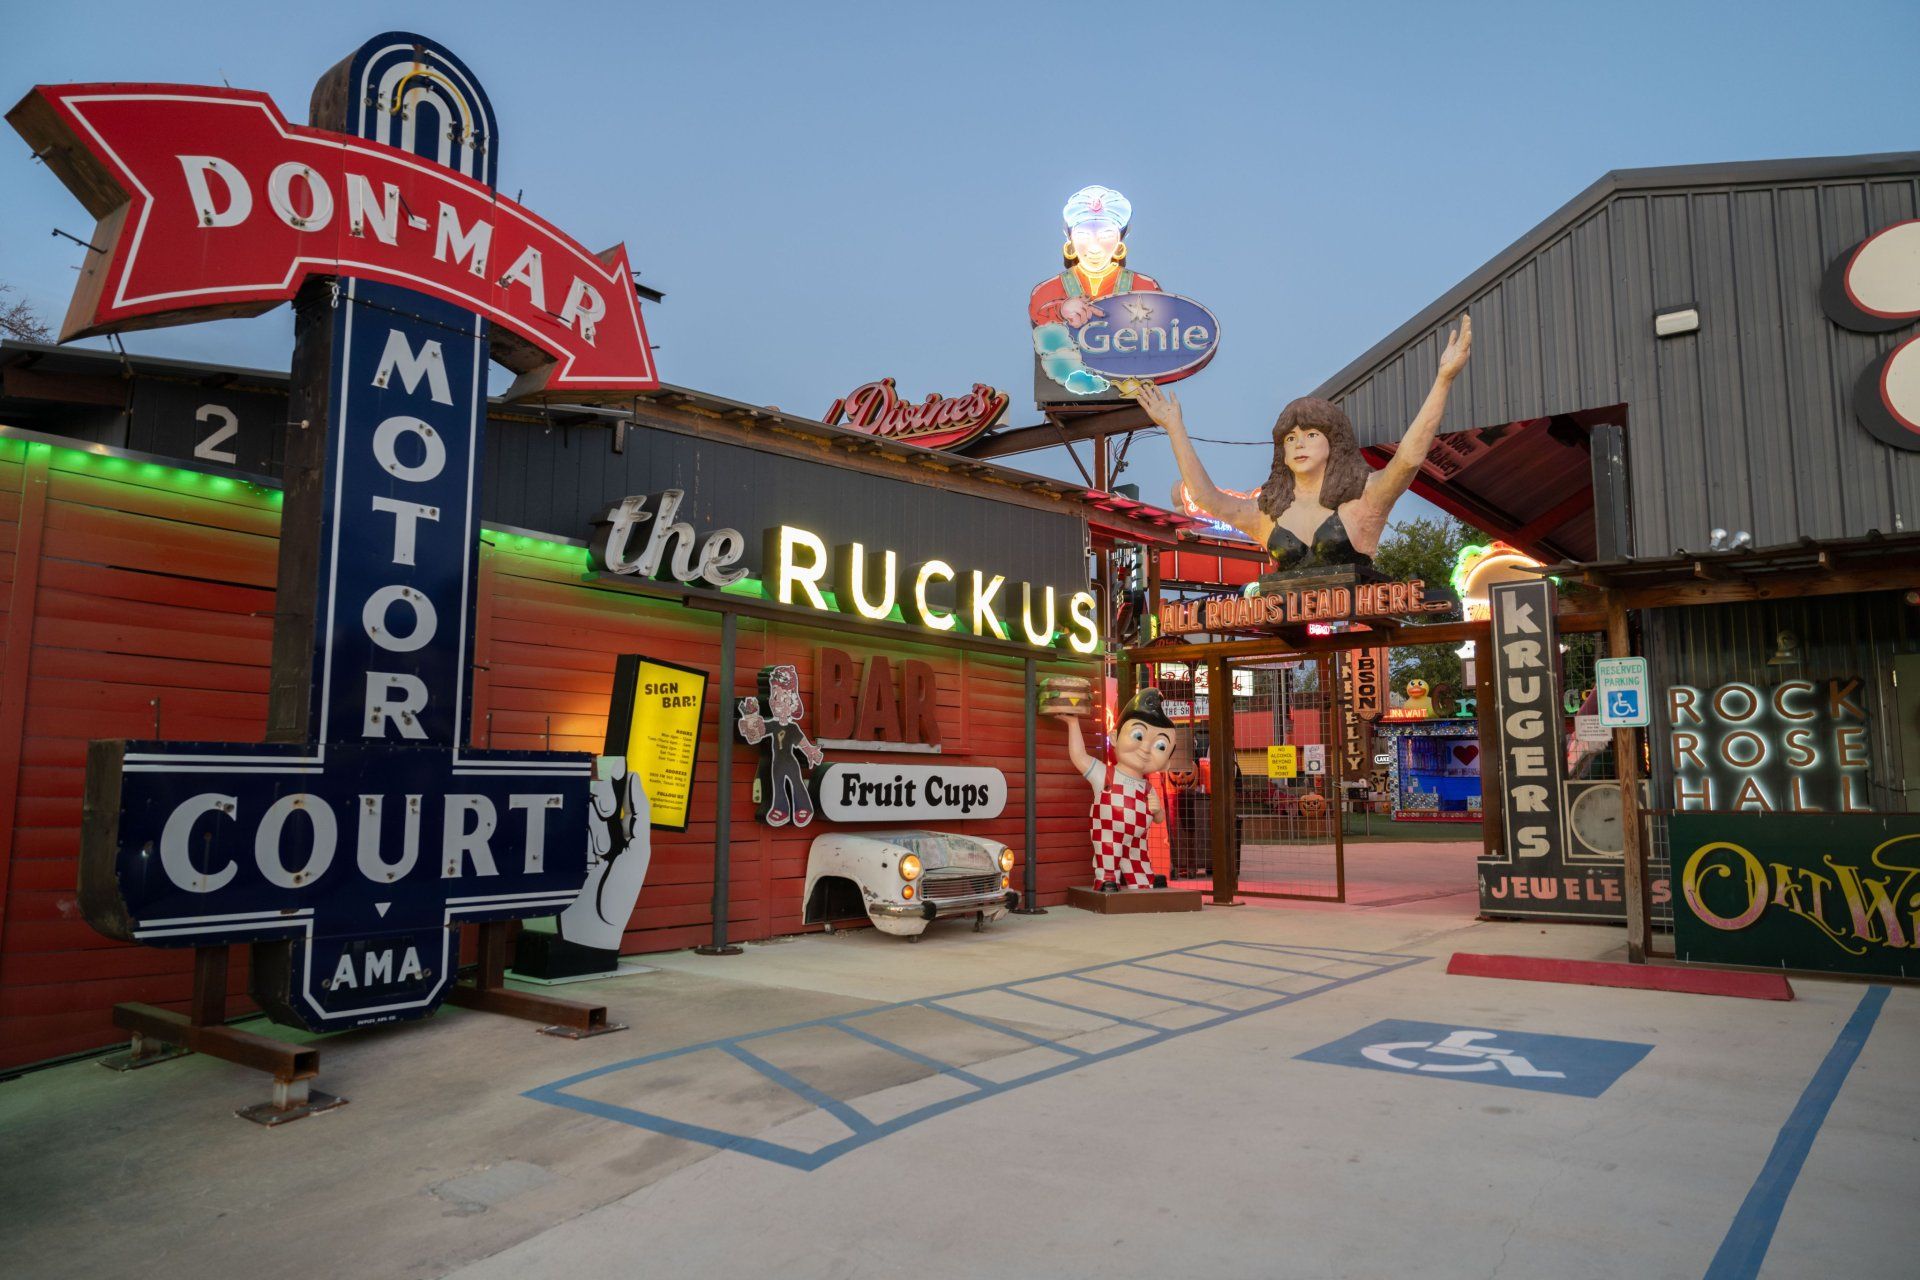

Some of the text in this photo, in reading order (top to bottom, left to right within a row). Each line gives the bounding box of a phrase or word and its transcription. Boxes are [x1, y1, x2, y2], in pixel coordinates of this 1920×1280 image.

[175, 155, 608, 349] DON-MAR
[1076, 318, 1211, 353] Genie
[194, 404, 240, 465] 2
[361, 328, 454, 739] MOTOR
[604, 488, 750, 588] the
[777, 525, 1099, 654] RUCKUS
[1160, 579, 1425, 633] ALL ROADS LEAD HERE
[645, 682, 679, 696] SIGN
[1600, 664, 1643, 676] RESERVED
[1604, 676, 1640, 687] PARKING
[661, 695, 697, 709] BAR!
[815, 647, 941, 748] BAR
[1669, 680, 1866, 725] ROCK
[1672, 728, 1869, 769] ROSE
[839, 773, 989, 814] Fruit Cups
[1675, 776, 1873, 812] HALL
[159, 792, 564, 893] COURT
[1491, 876, 1672, 905] JEWELES
[329, 946, 425, 991] AMA
